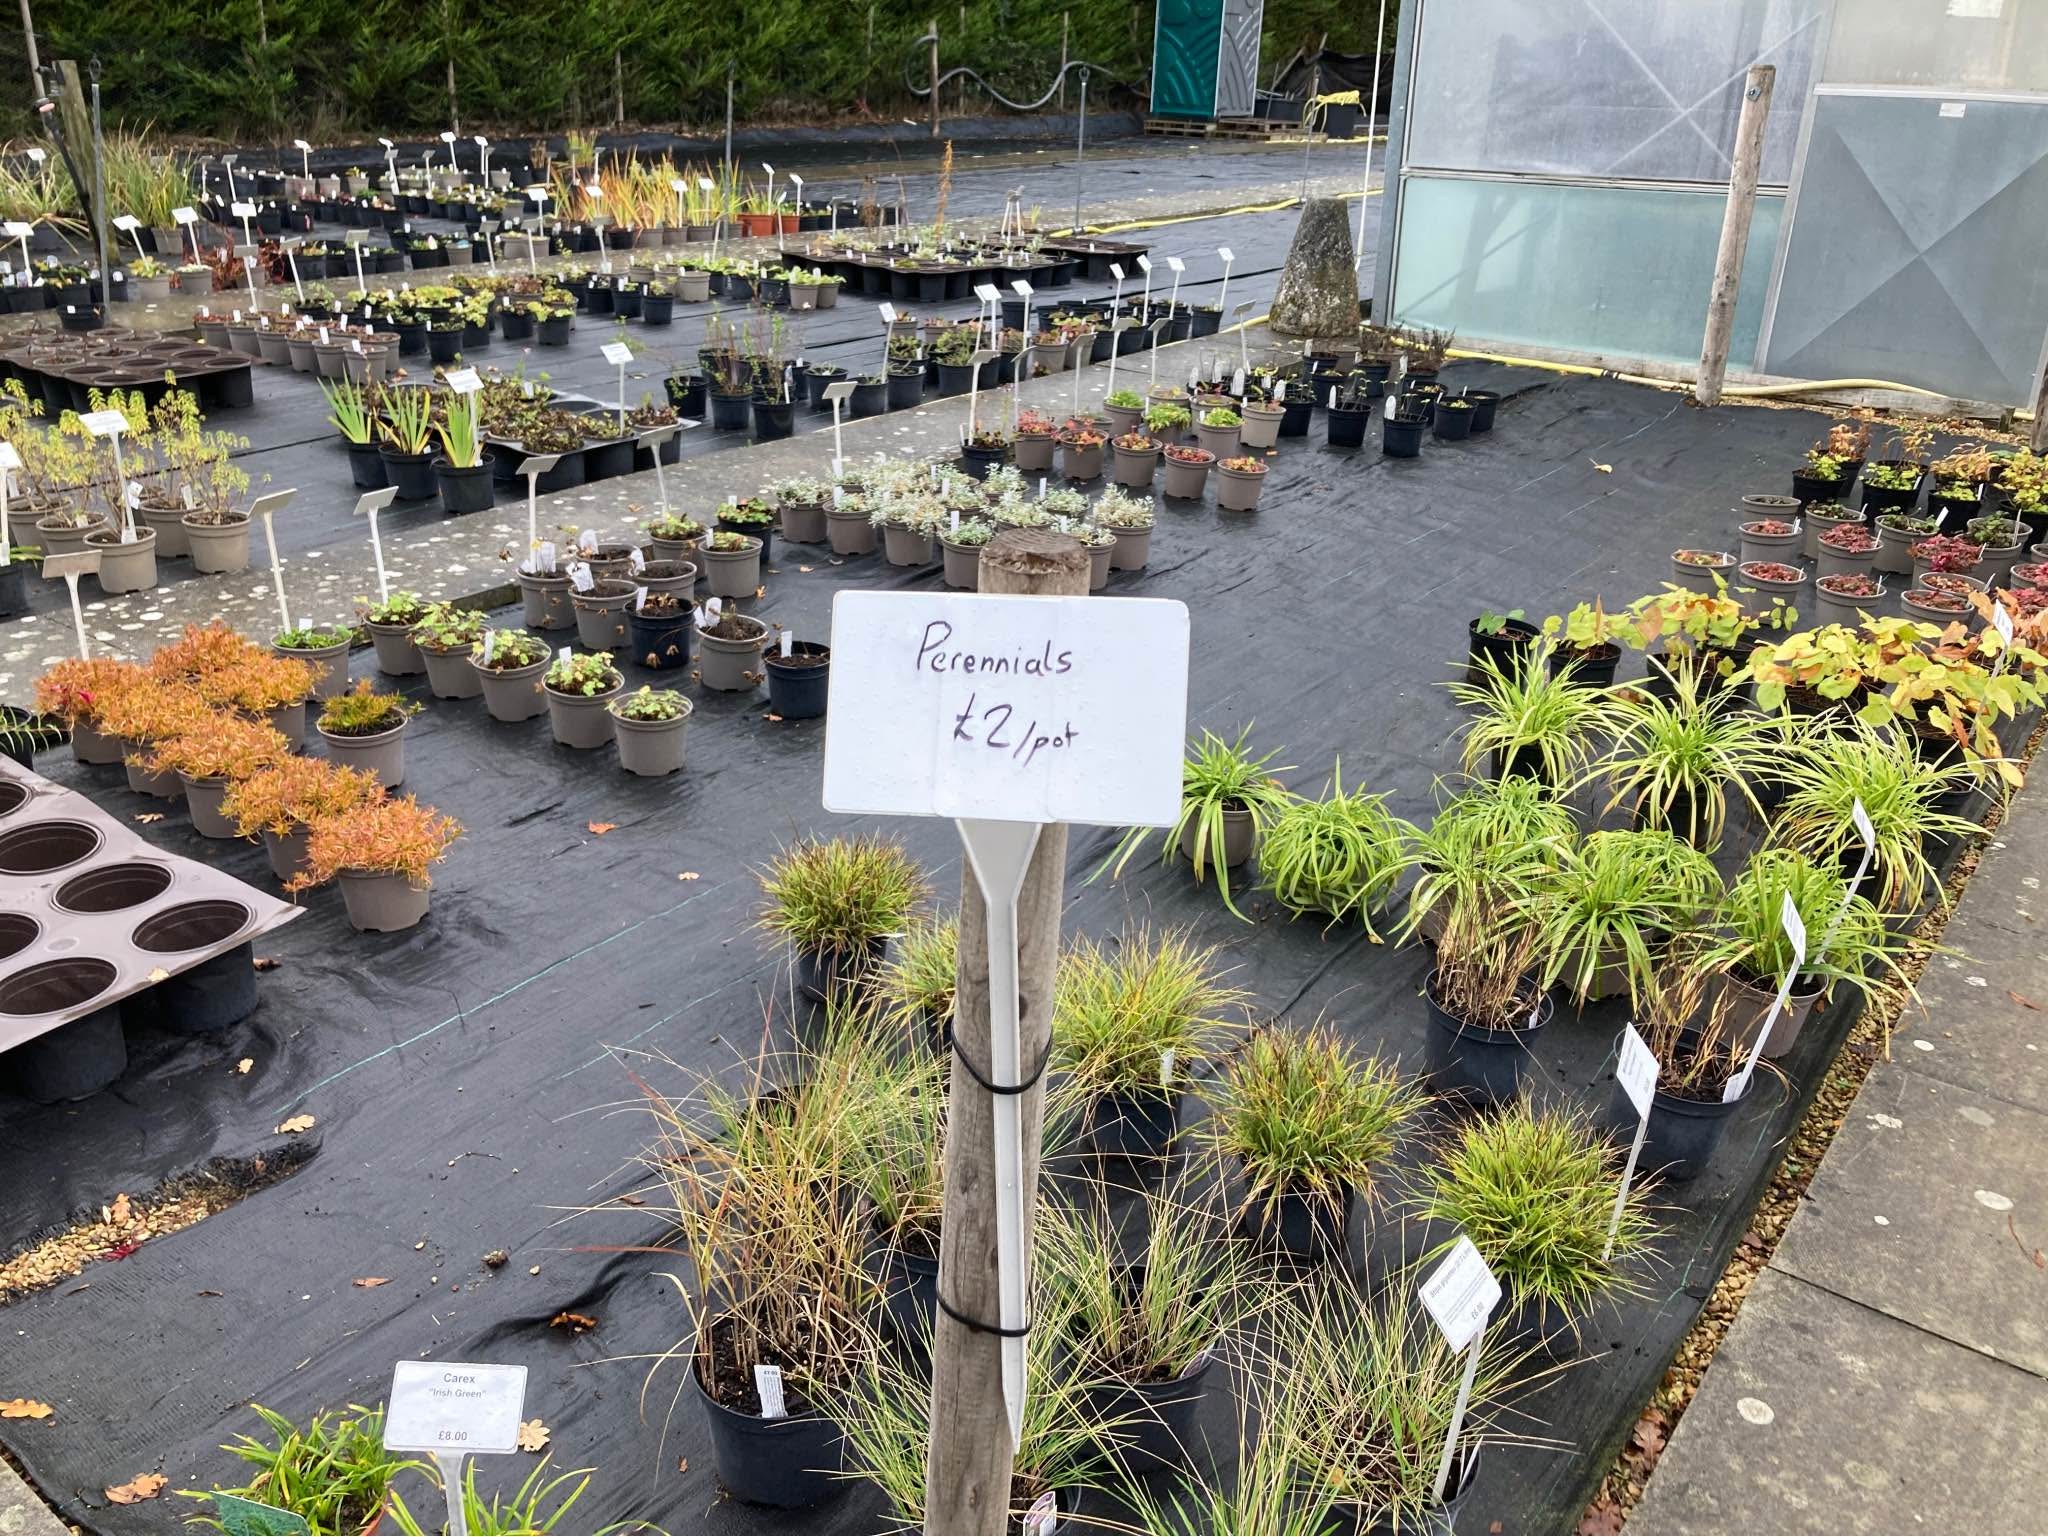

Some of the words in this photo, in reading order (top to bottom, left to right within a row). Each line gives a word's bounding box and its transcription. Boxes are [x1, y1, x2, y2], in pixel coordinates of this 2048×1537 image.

[916, 620, 1073, 676] Perennials
[953, 692, 1080, 767] £2/pot
[443, 1372, 476, 1384] Carex
[438, 1430, 468, 1441] £8.00
